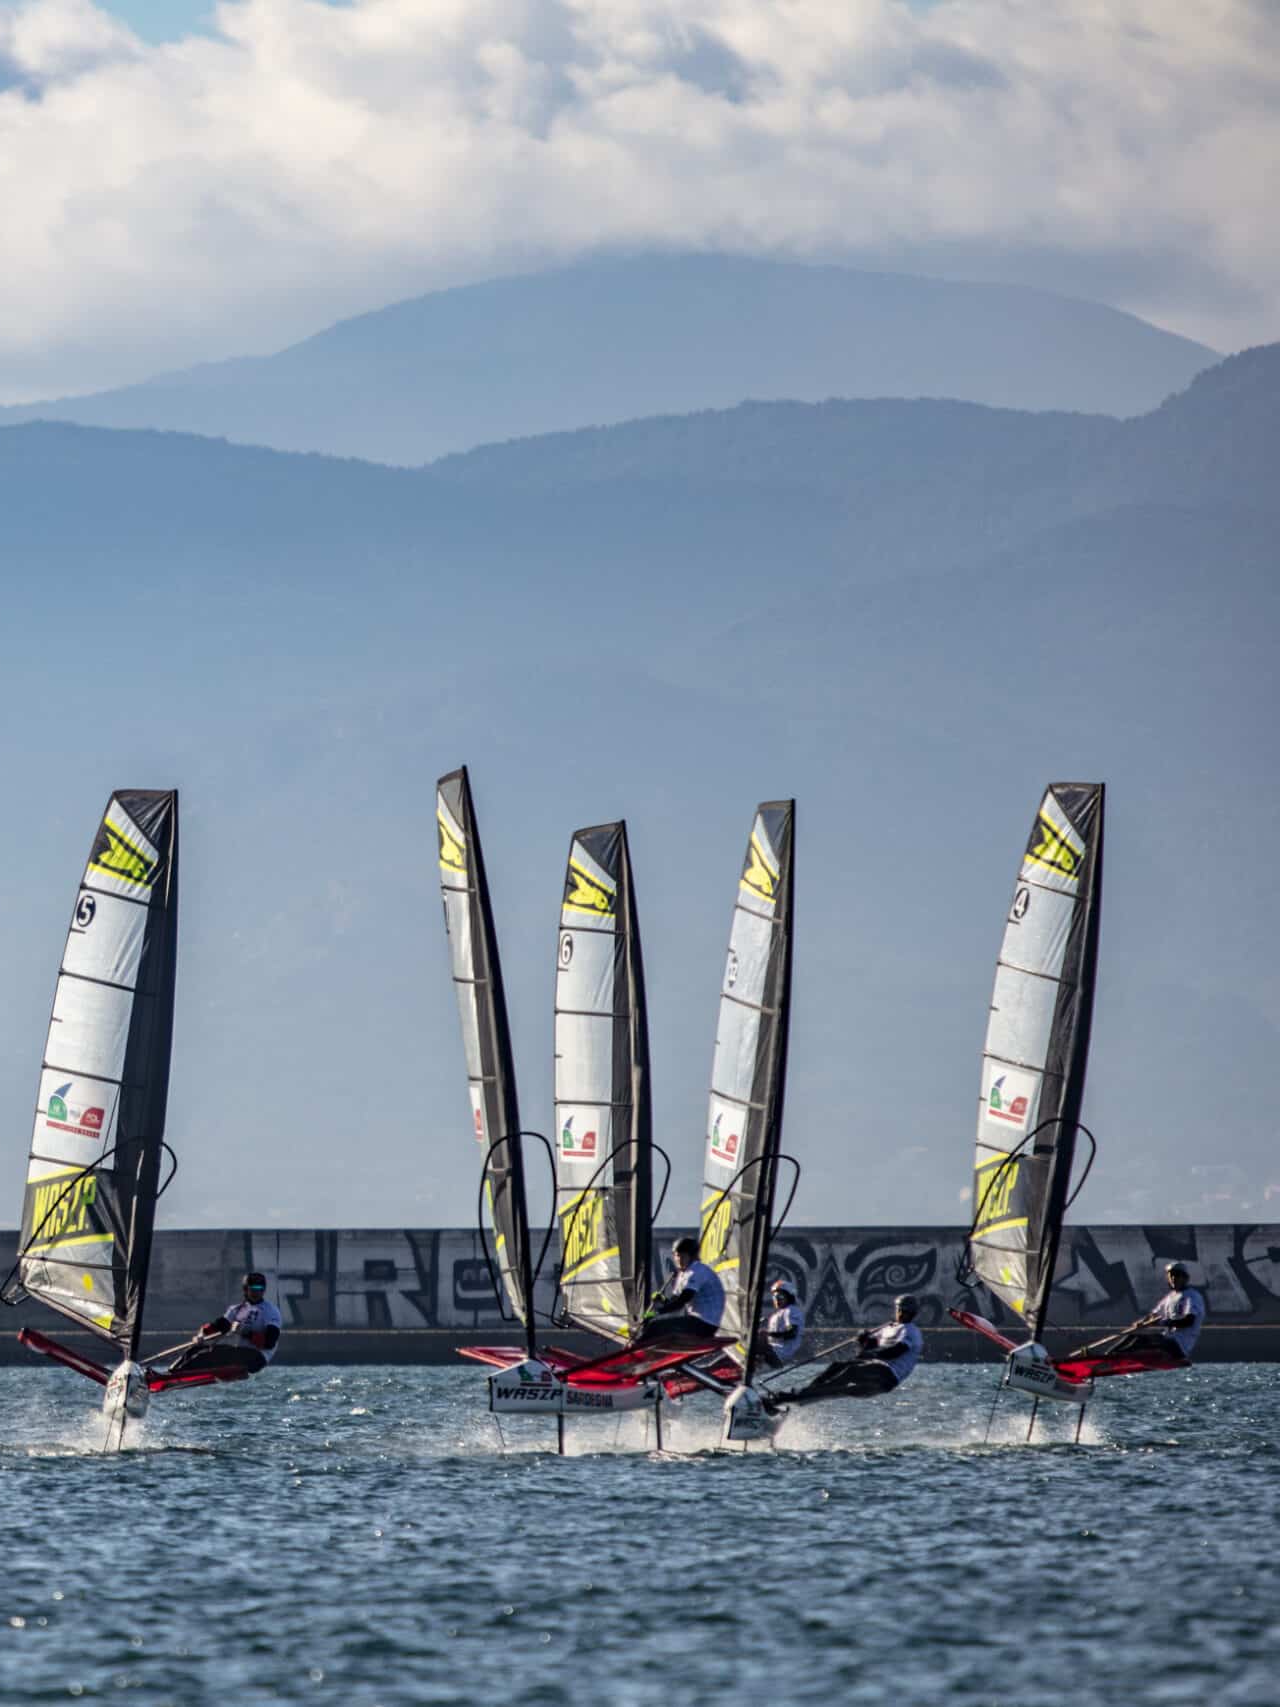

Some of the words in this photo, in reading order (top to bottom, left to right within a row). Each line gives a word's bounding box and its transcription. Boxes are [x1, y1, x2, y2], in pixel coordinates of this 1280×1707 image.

[78, 897, 93, 925] 5
[562, 936, 571, 962] 6
[496, 1387, 563, 1400] WASZP
